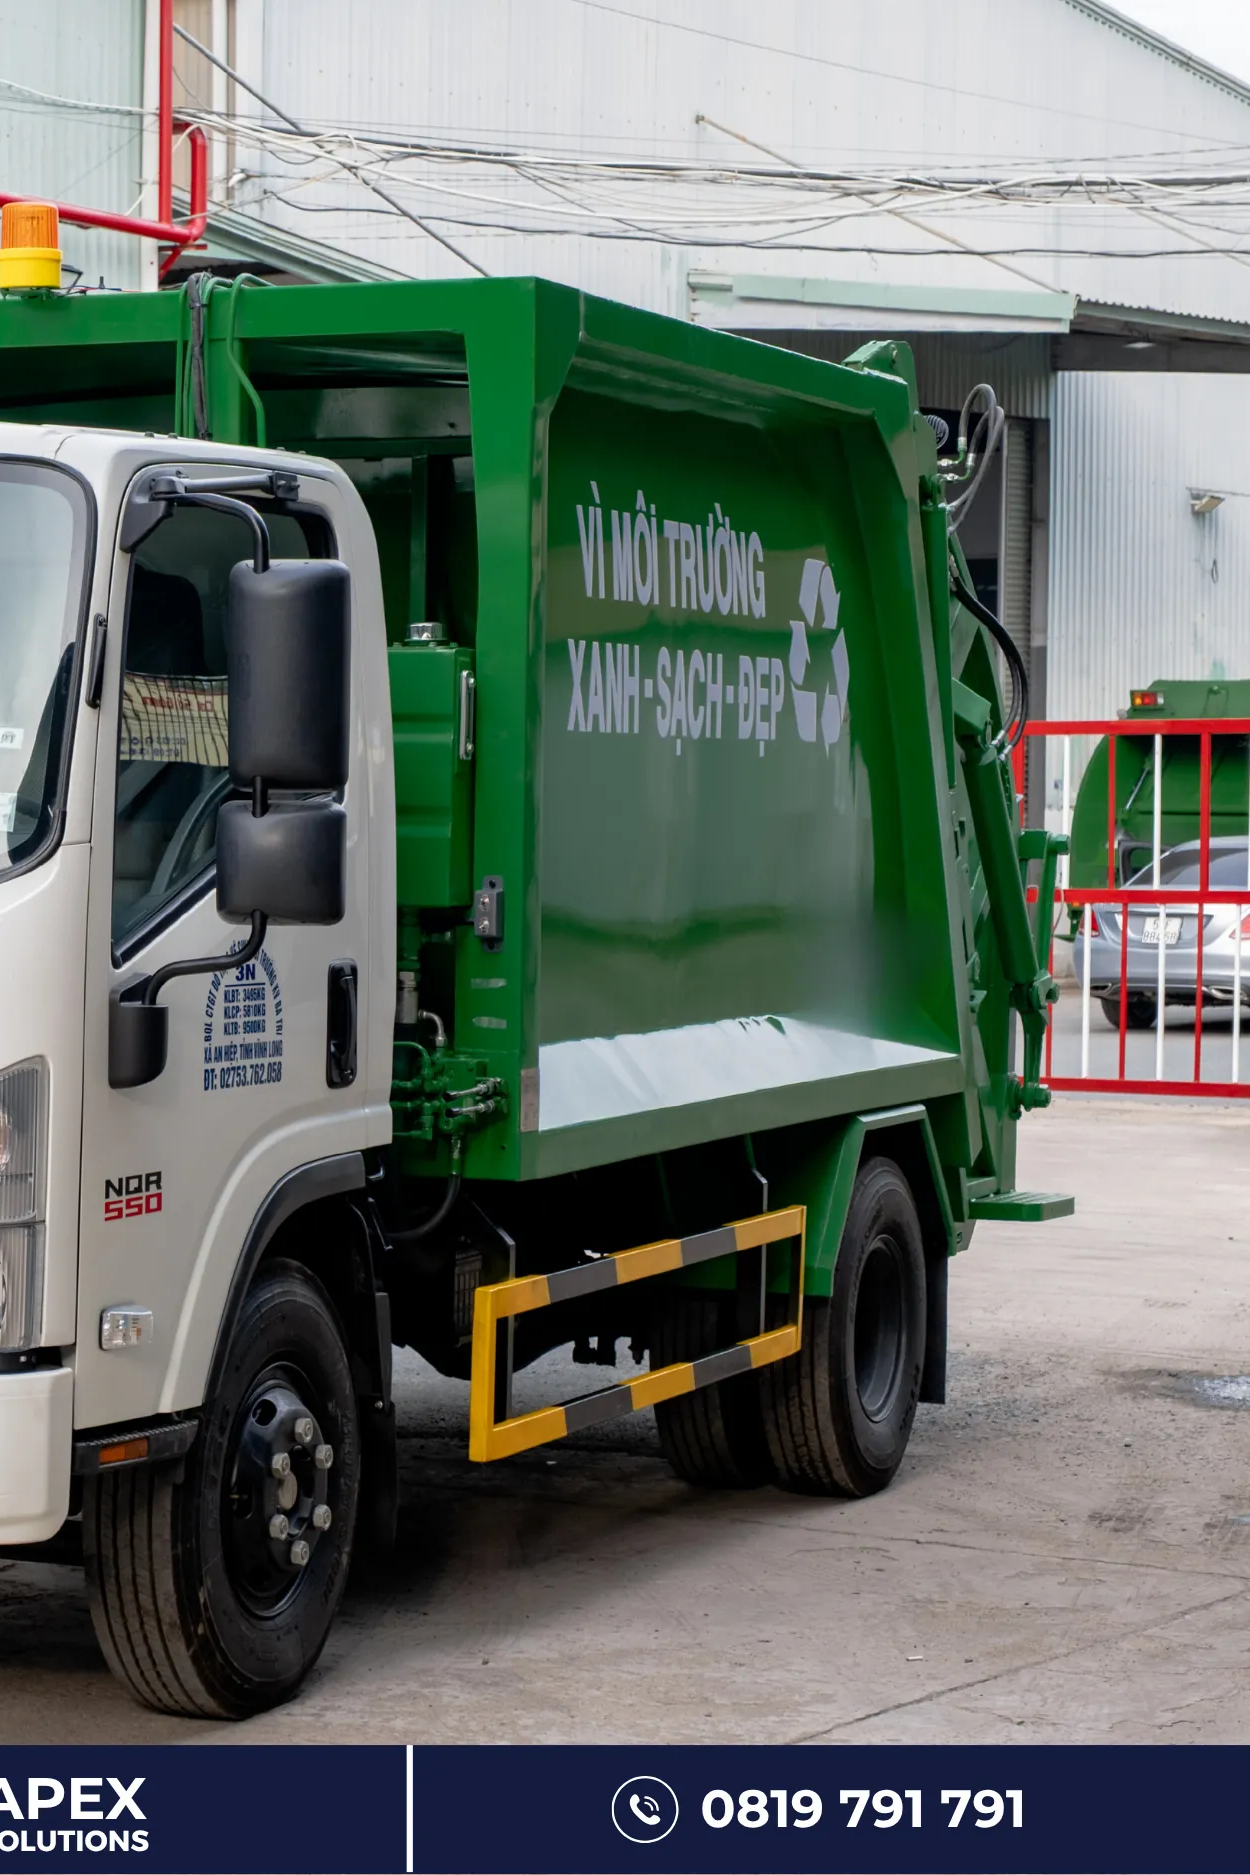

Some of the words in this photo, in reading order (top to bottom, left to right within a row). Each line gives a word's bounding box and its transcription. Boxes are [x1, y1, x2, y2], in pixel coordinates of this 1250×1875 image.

[576, 481, 605, 598] VÌ
[611, 490, 660, 606] MÔI
[663, 503, 766, 619] TRƯỜNG
[235, 964, 255, 981] 3N
[205, 989, 217, 1018] CTGT
[224, 989, 240, 1003] KLBT:
[224, 1005, 241, 1019] KLCP:
[204, 1021, 213, 1042] BQL
[224, 1021, 240, 1036] KLTB:
[243, 1019, 265, 1034] 9500KG
[214, 1045, 223, 1063] AN
[268, 1040, 283, 1058] LONG
[105, 1171, 162, 1199] NQR
[104, 1192, 162, 1221] 550
